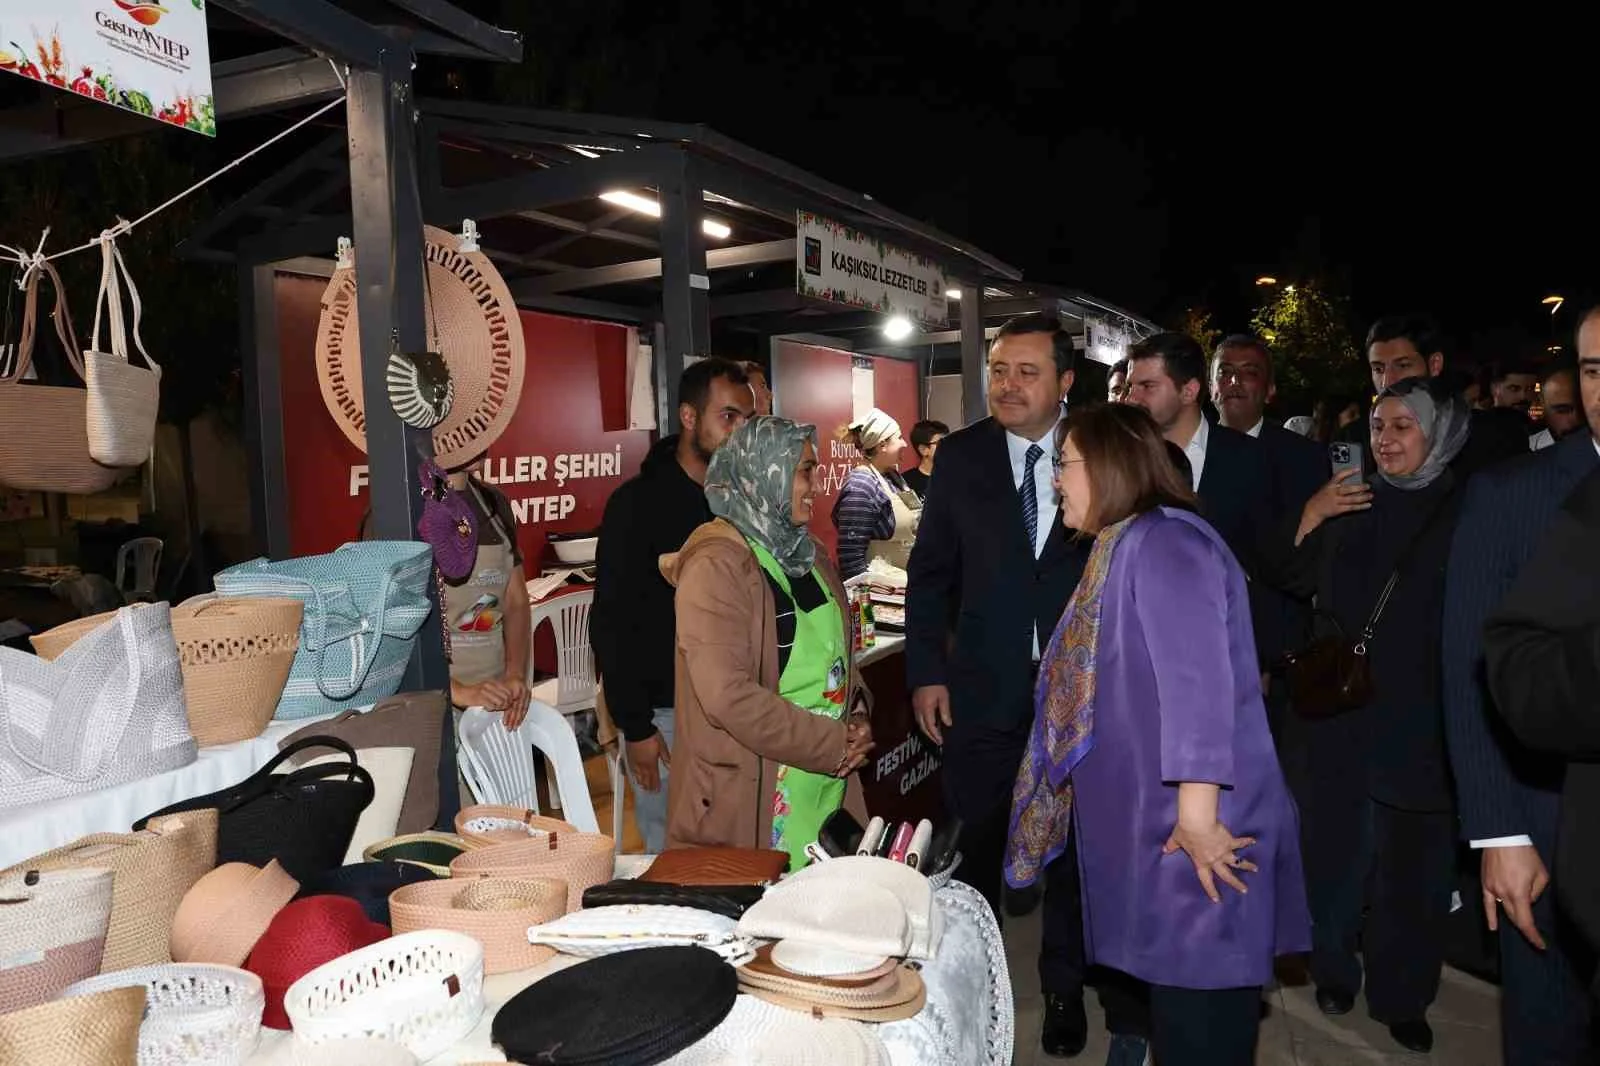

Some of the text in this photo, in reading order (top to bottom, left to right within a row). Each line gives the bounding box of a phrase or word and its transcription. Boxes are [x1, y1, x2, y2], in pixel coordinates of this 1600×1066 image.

[831, 251, 927, 297] KAŞIKSIZ LEZZETLER
[553, 443, 621, 487] ŞEHRİ
[876, 732, 921, 782] FESTİV
